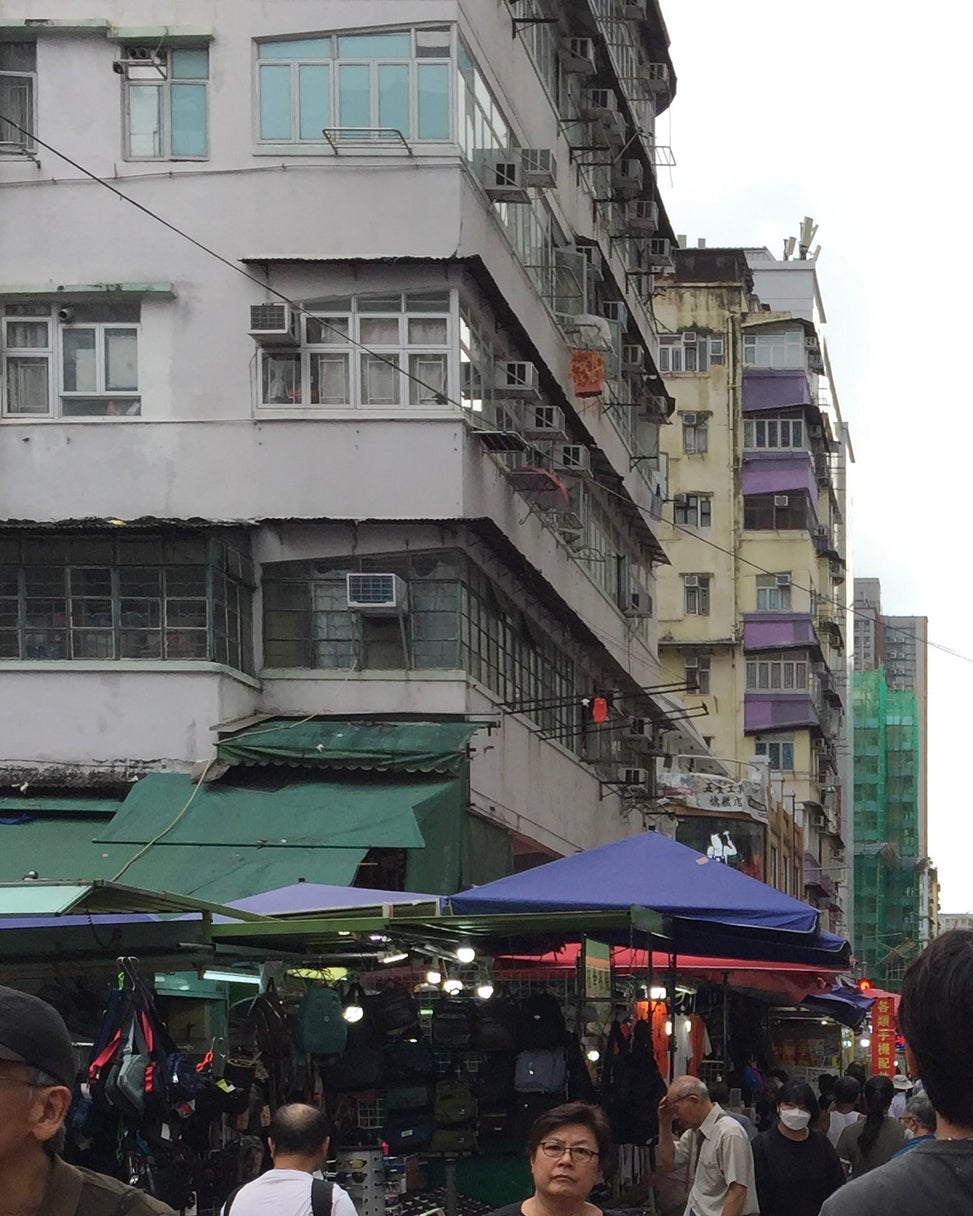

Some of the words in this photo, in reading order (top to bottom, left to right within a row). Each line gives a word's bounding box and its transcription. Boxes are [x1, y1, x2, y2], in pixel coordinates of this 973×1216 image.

[877, 1000, 891, 1077] 各類手機配
